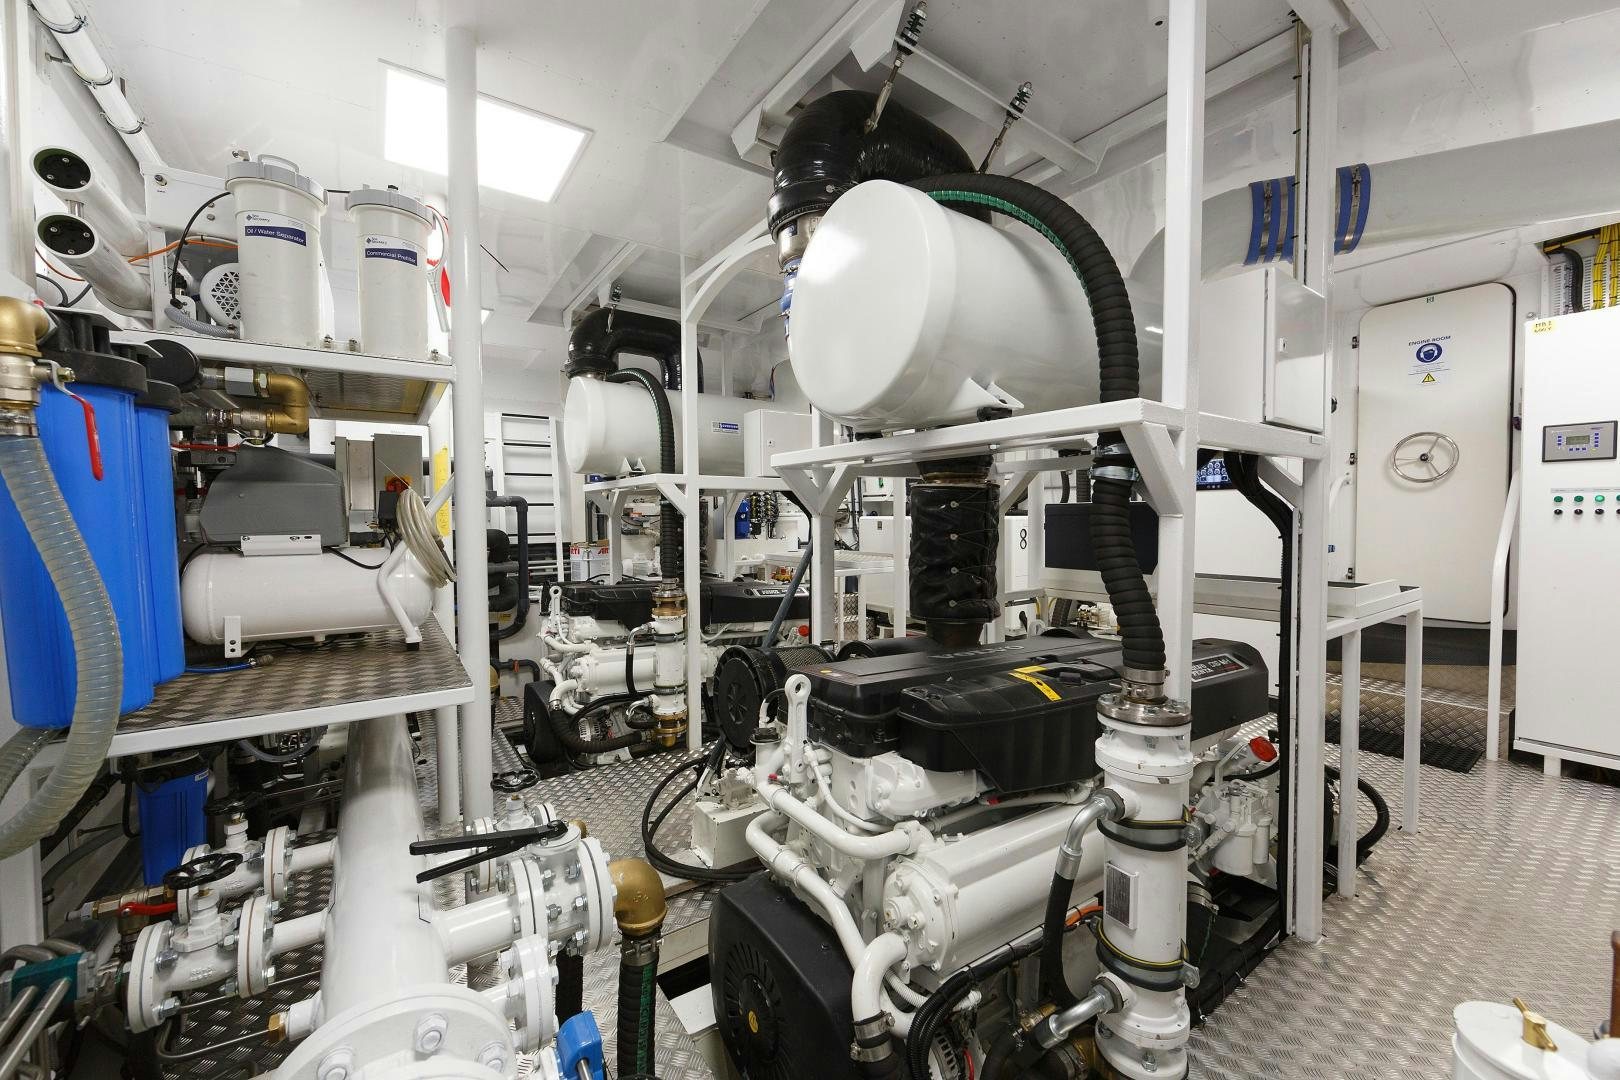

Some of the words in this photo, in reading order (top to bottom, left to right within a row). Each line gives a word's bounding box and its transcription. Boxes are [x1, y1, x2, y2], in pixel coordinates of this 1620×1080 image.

[276, 231, 305, 243] Separator
[366, 250, 397, 259] Commercial
[1408, 338, 1431, 347] ENGINE
